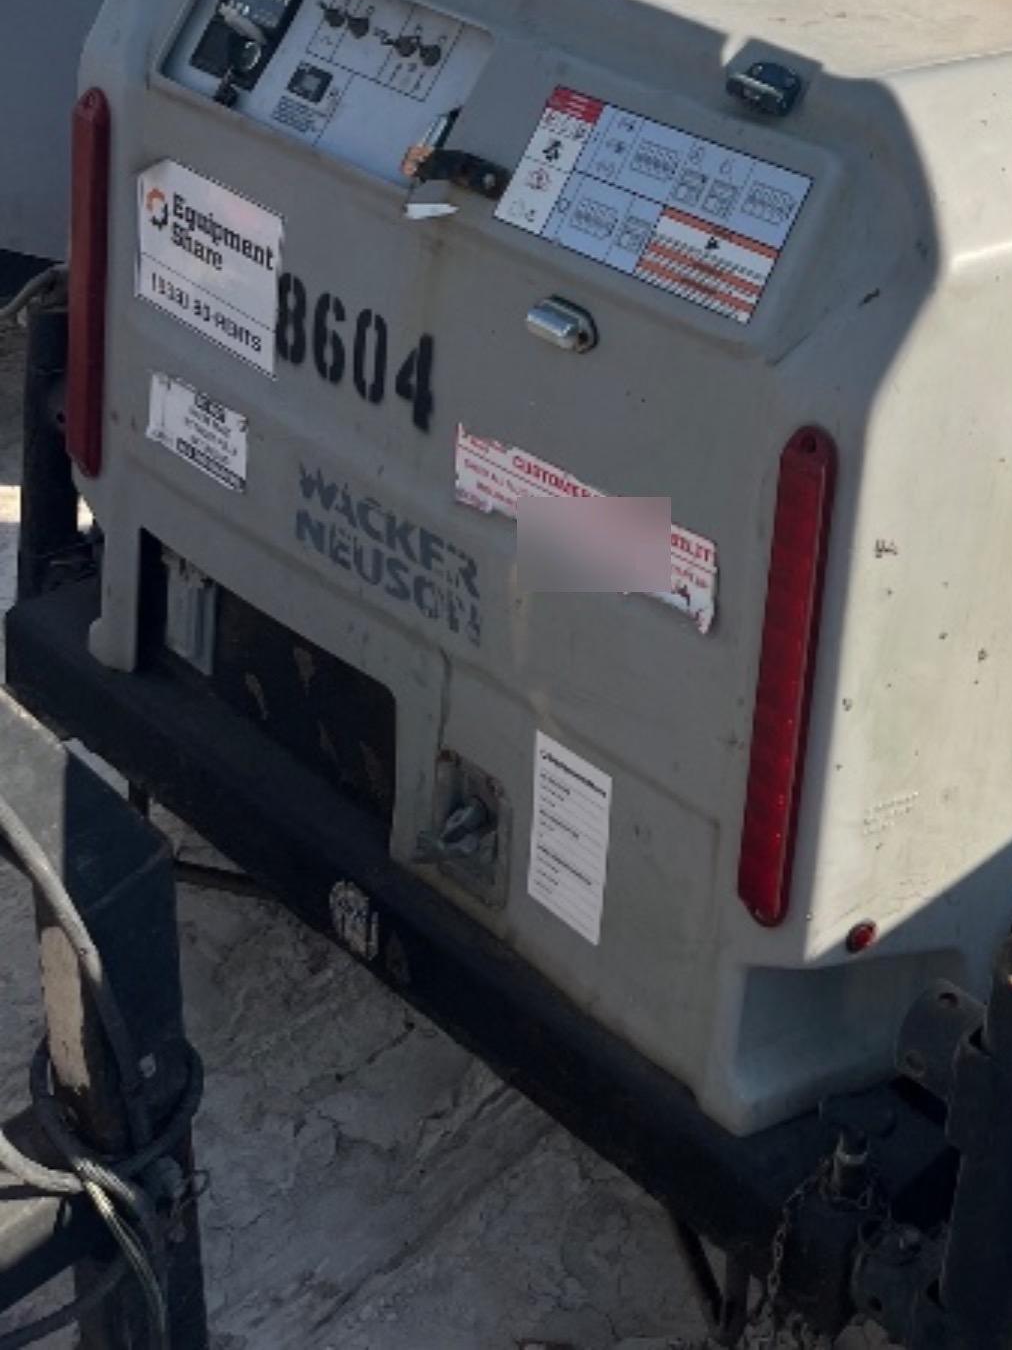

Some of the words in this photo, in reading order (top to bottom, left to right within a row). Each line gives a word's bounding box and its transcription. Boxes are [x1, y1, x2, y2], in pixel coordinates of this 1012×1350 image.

[170, 220, 224, 271] Share
[171, 192, 275, 271] Equipment
[274, 270, 437, 433] 8604
[299, 462, 480, 600] WACKER
